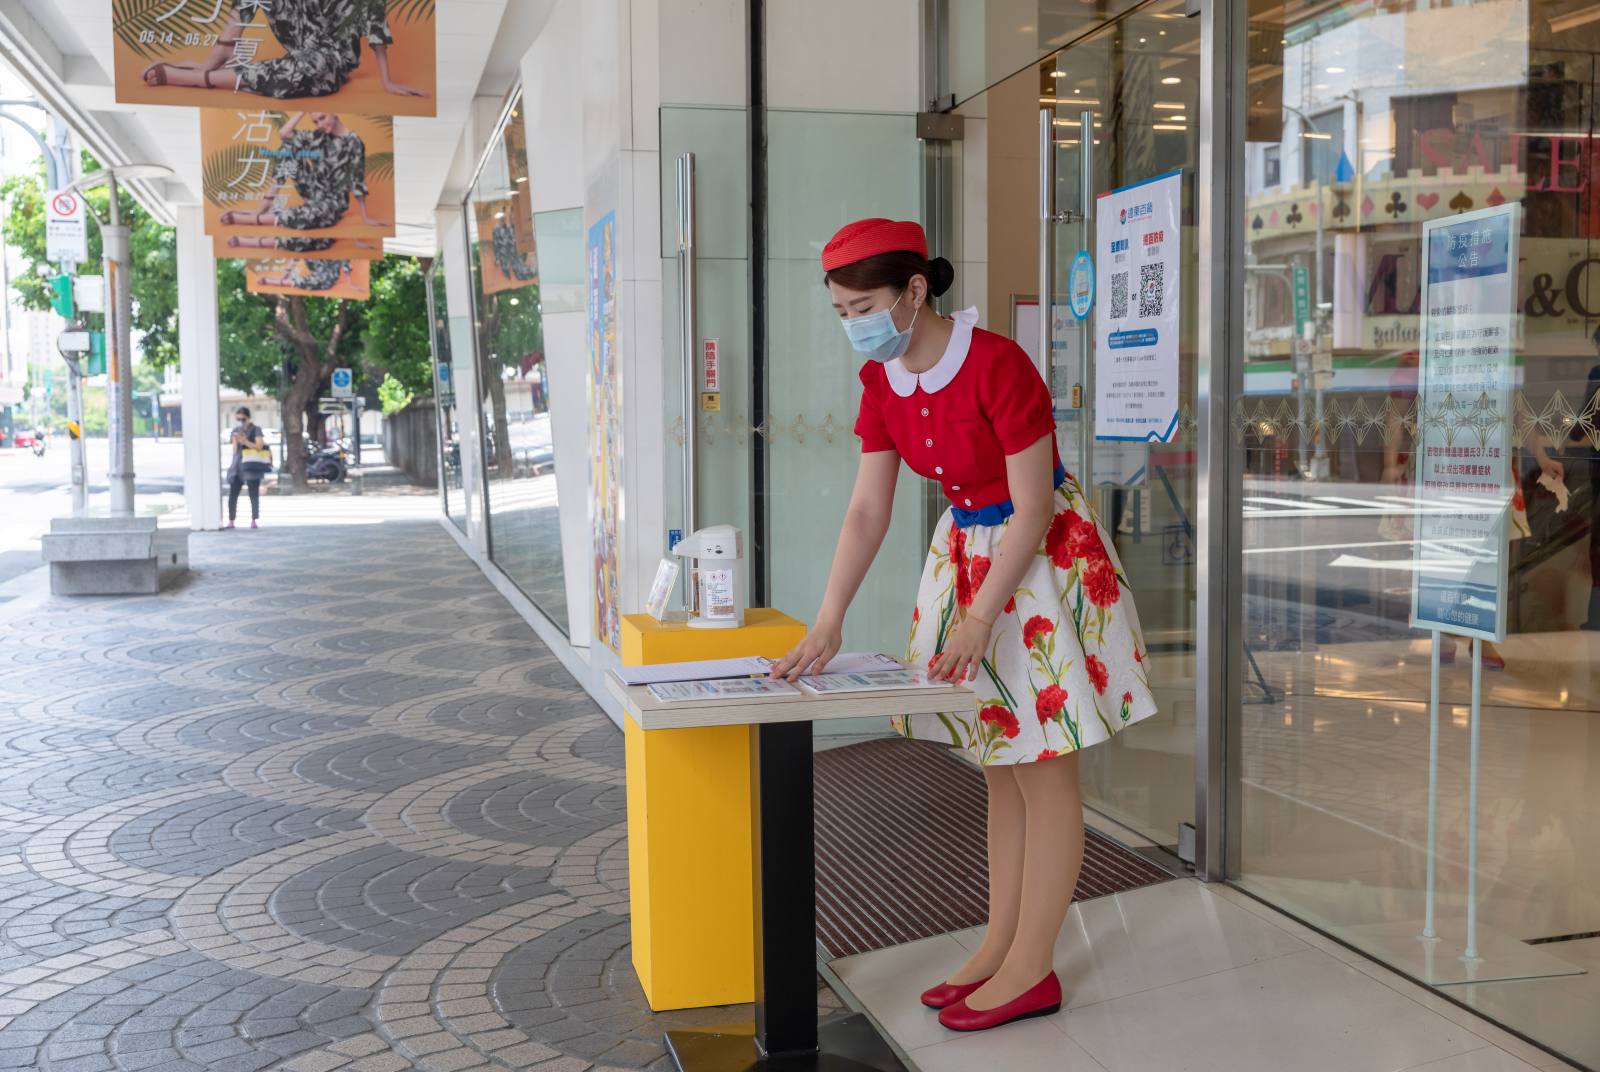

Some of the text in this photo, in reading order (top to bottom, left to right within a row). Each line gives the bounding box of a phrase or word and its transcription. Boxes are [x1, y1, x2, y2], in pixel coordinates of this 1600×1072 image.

[1420, 127, 1589, 193] SALE
[1448, 228, 1493, 250] 防疫措施
[1458, 250, 1481, 268] 公告
